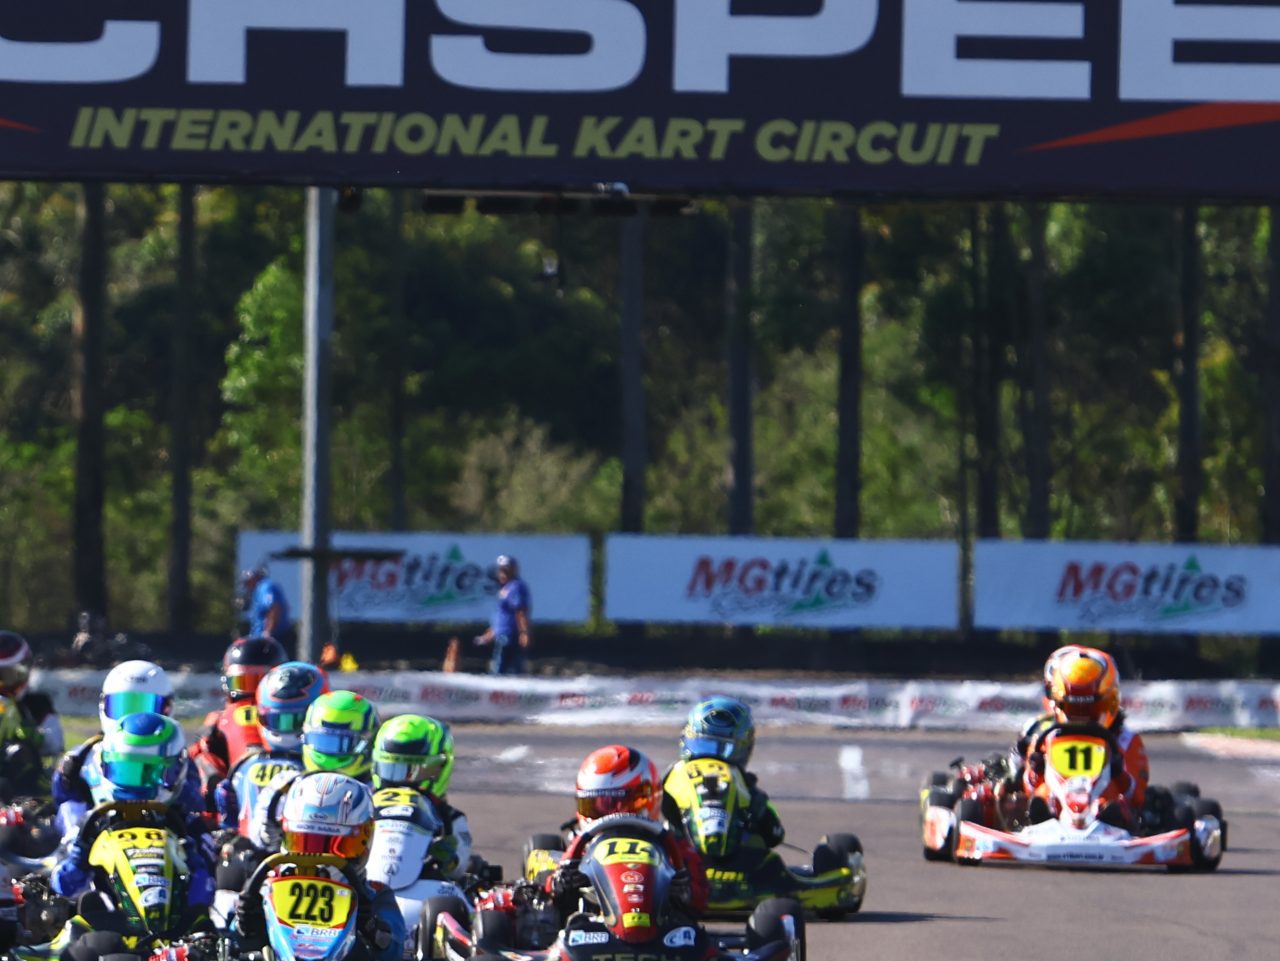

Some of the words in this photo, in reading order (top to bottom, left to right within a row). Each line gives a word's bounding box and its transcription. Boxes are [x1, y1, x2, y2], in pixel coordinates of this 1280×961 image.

[70, 107, 558, 155] INTERNATIONAL
[573, 116, 744, 161] KART
[754, 119, 999, 166] CIRCUIT
[687, 553, 878, 601] MGtires
[1057, 560, 1247, 607] MGtires
[1064, 746, 1093, 771] 11
[288, 882, 335, 923] 223
